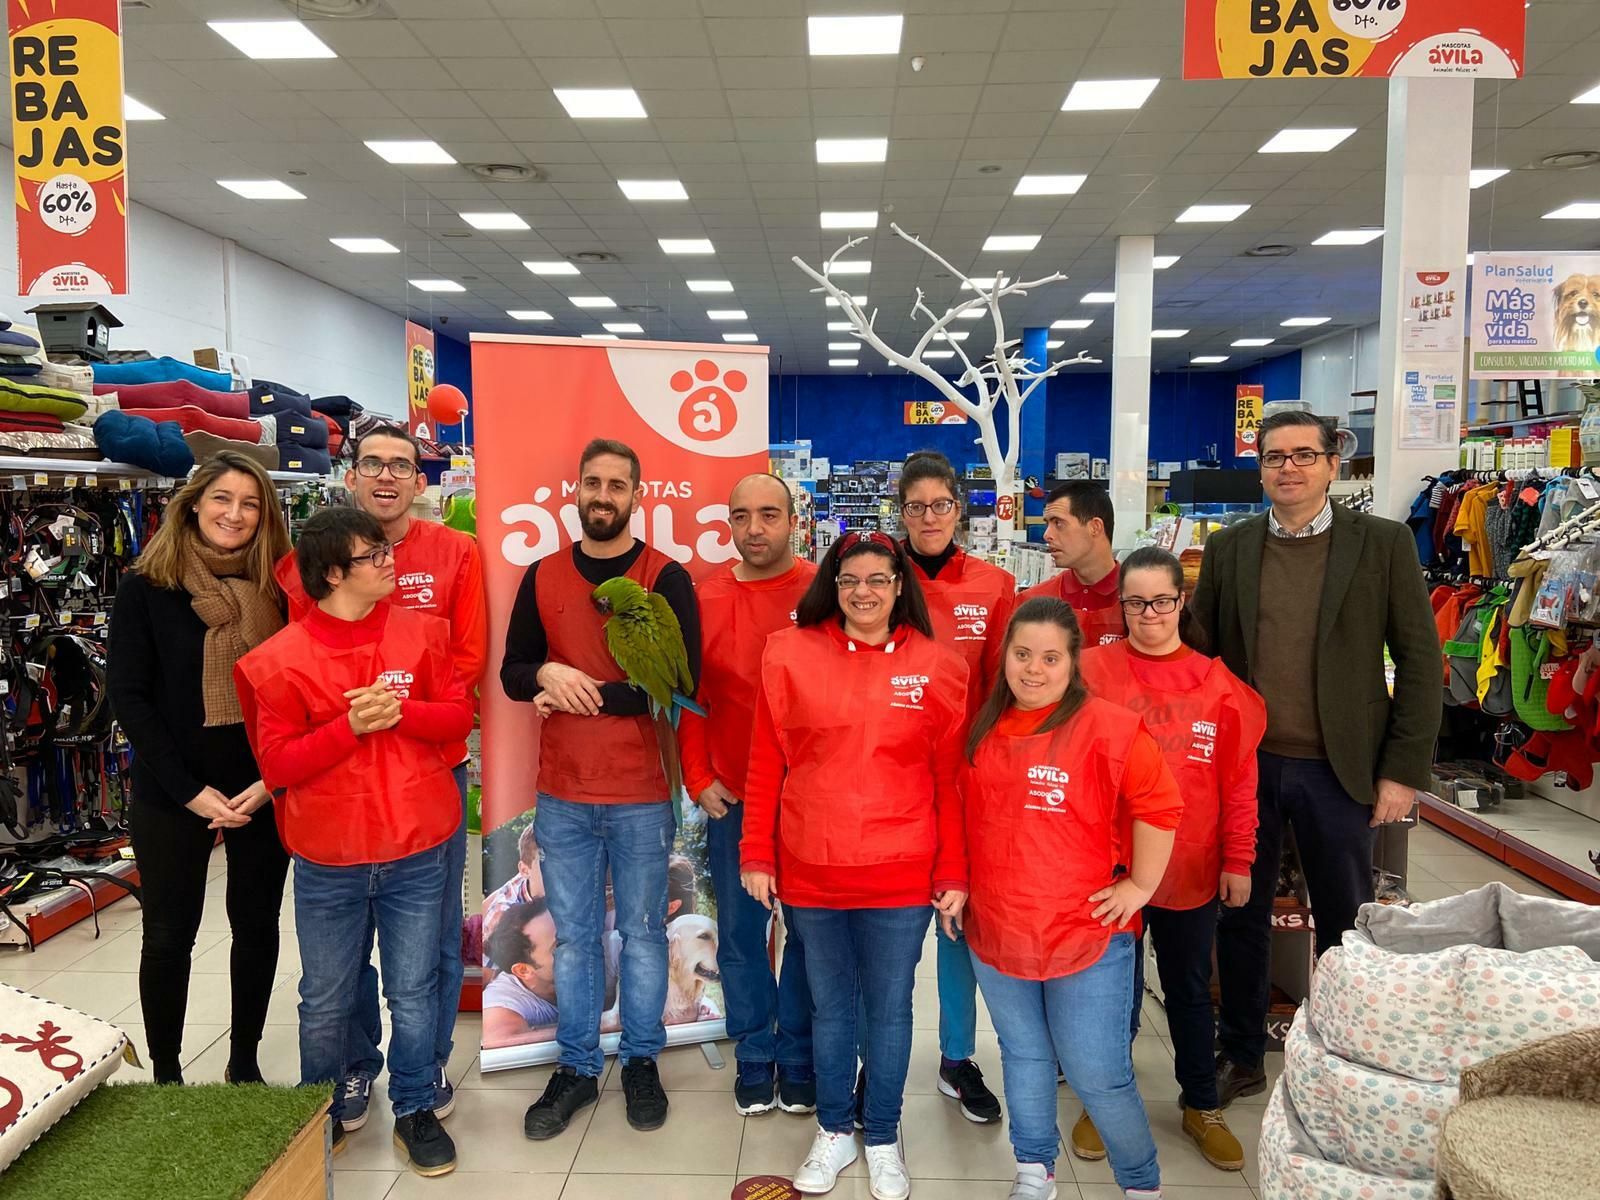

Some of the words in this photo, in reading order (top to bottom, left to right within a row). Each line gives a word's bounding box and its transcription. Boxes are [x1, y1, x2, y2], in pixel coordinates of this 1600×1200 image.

[1250, 0, 1319, 33] BA
[1355, 15, 1378, 28] Dto.
[13, 36, 79, 77] RE
[1249, 38, 1349, 77] JAS
[15, 81, 88, 122] BA
[18, 126, 123, 168] JAS
[56, 182, 77, 190] Hasta
[43, 191, 92, 213] 60%
[59, 215, 76, 226] Dto.
[1485, 265, 1553, 276] PlanSalud
[1487, 288, 1534, 310] Más
[1493, 311, 1500, 322] y
[1503, 310, 1534, 321] mejor
[1486, 321, 1527, 337] vida
[413, 349, 423, 366] RE
[413, 367, 425, 384] BA
[1238, 400, 1253, 408] RE
[916, 409, 929, 417] BA
[1238, 410, 1255, 418] BA
[1237, 420, 1262, 428] JAS
[562, 480, 692, 498] MTAS
